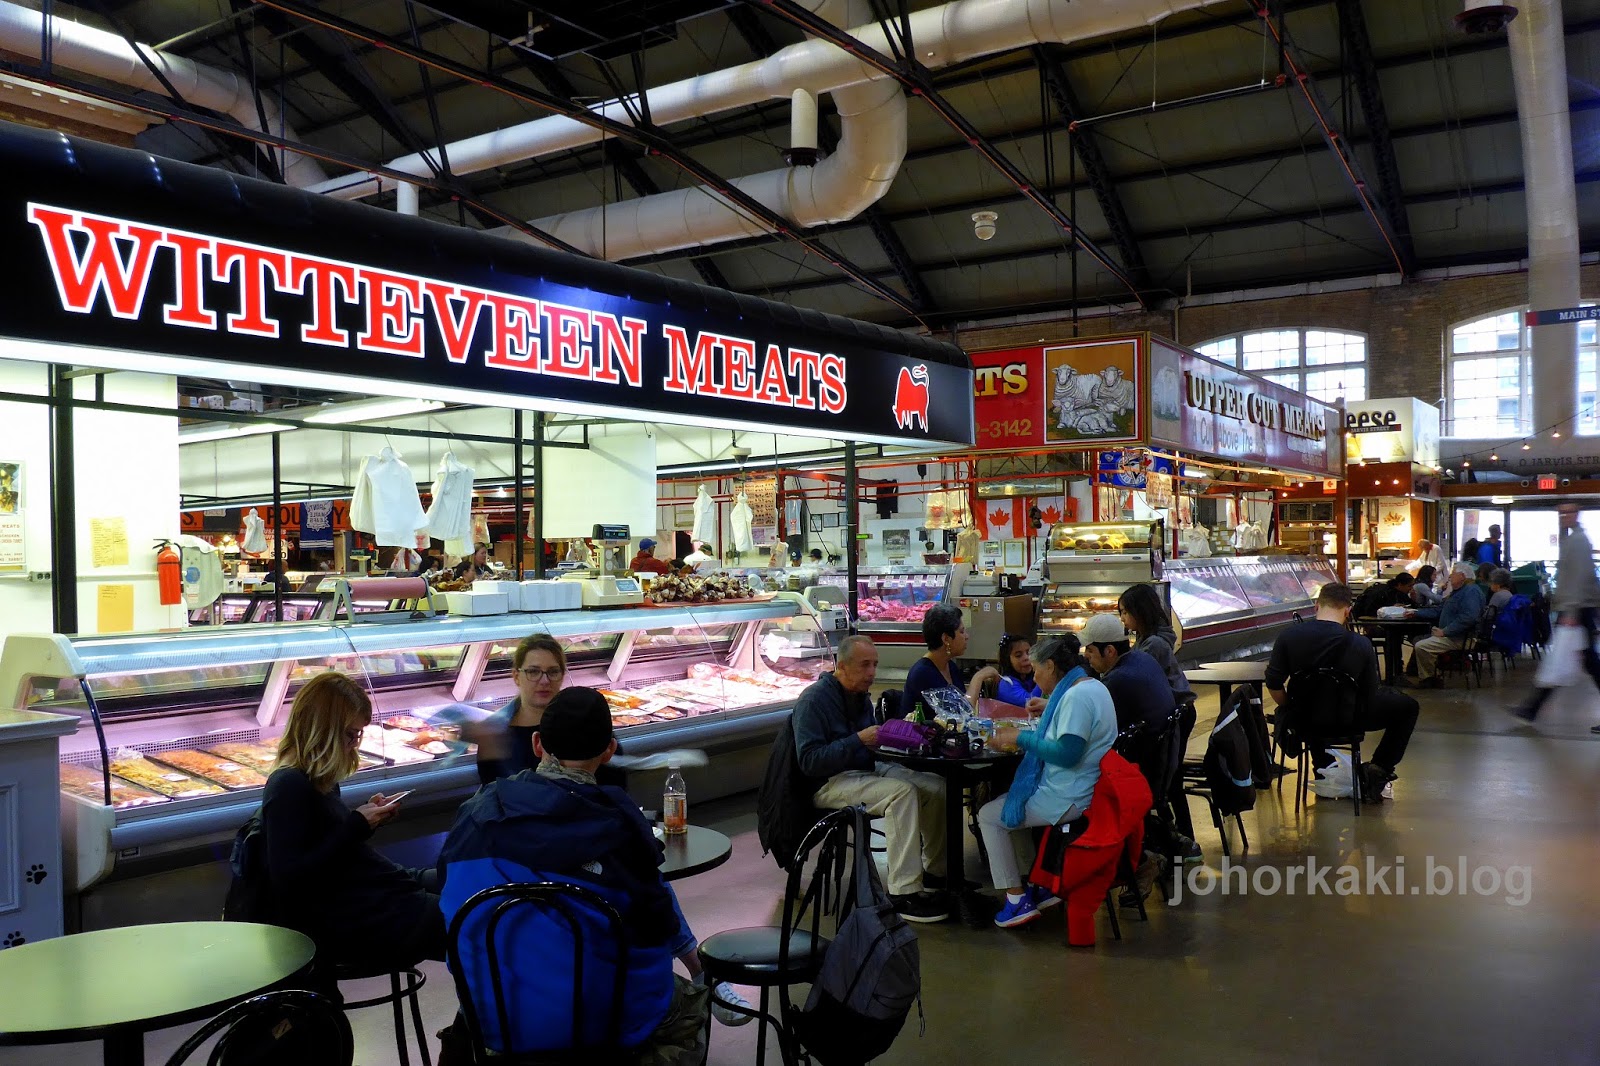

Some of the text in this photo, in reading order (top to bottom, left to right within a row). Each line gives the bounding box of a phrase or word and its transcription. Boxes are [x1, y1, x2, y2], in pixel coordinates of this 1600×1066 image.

[27, 202, 847, 414] WITTEVEEN MEATS
[1559, 310, 1587, 320] MAIN
[974, 364, 1028, 396] TS
[1185, 371, 1326, 440] UPPER CUT MEATS
[1218, 423, 1239, 451] Above
[1532, 456, 1573, 466] JARVIS
[267, 505, 345, 525] POUY
